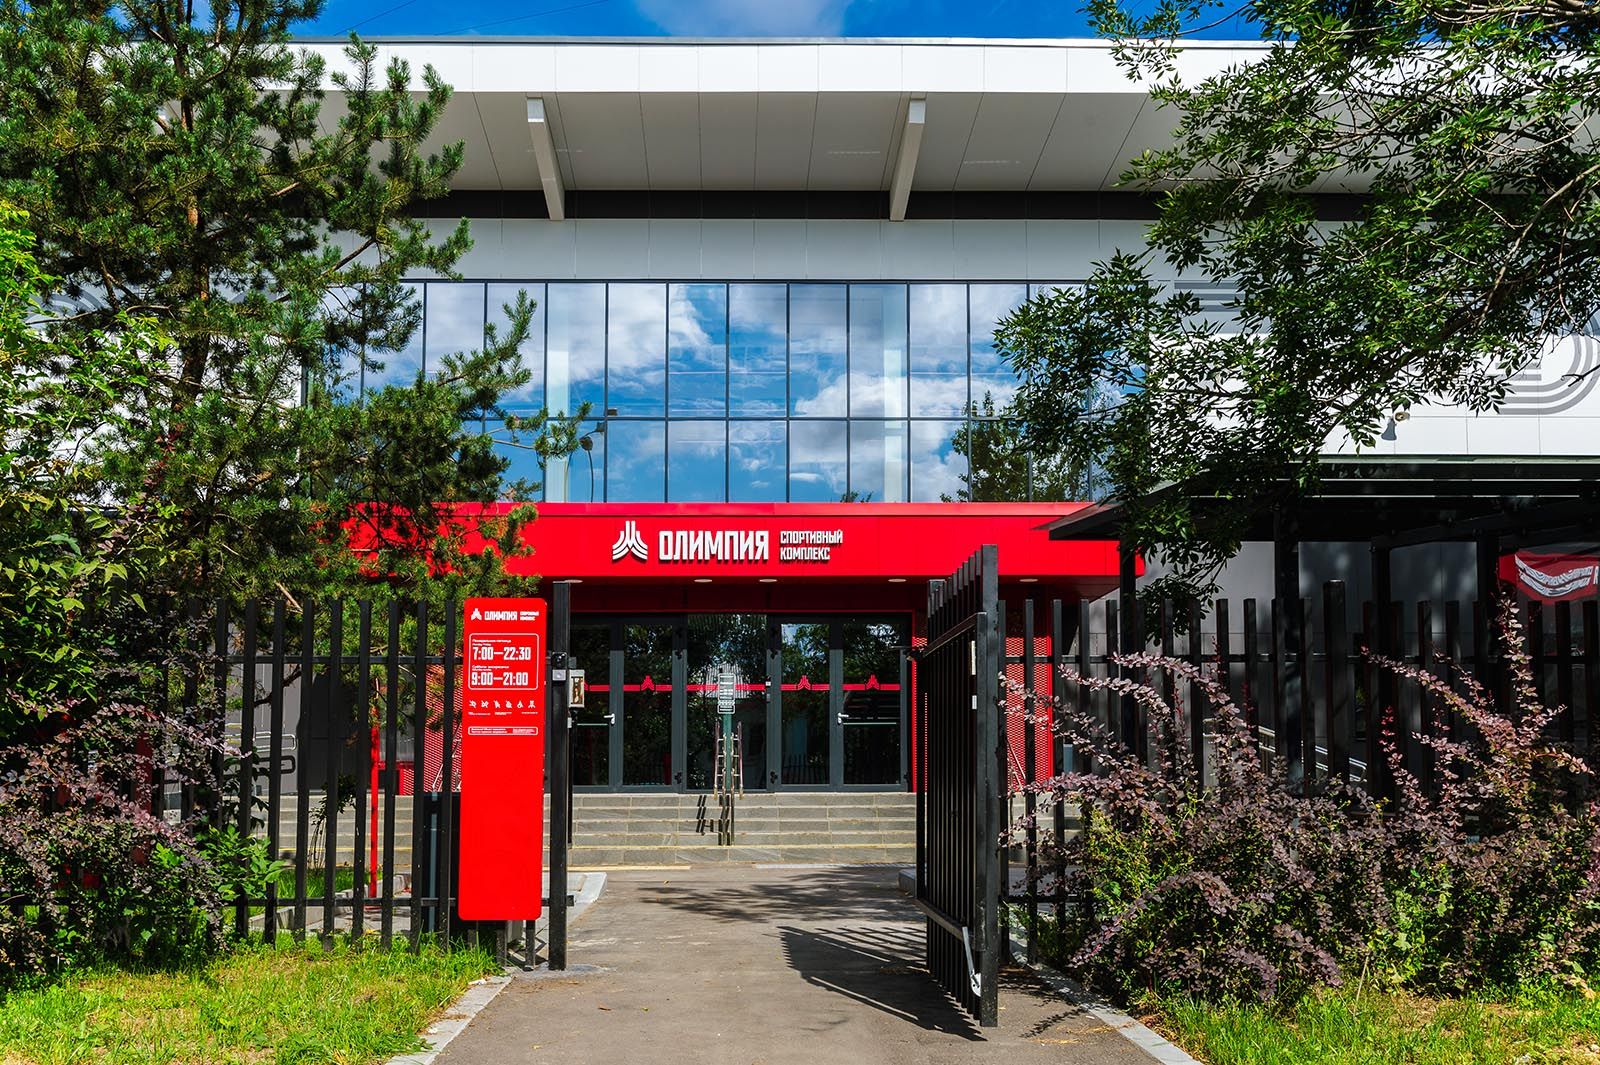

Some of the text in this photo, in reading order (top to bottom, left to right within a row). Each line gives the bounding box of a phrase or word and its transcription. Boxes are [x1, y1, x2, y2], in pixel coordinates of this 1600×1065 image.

[780, 529, 843, 544] СПОРТИВНЫЙ
[659, 530, 769, 560] ОЛИМПИЯ
[780, 546, 830, 560] КОМПЛЕКС
[484, 611, 518, 621] ОЛИМПИЯ
